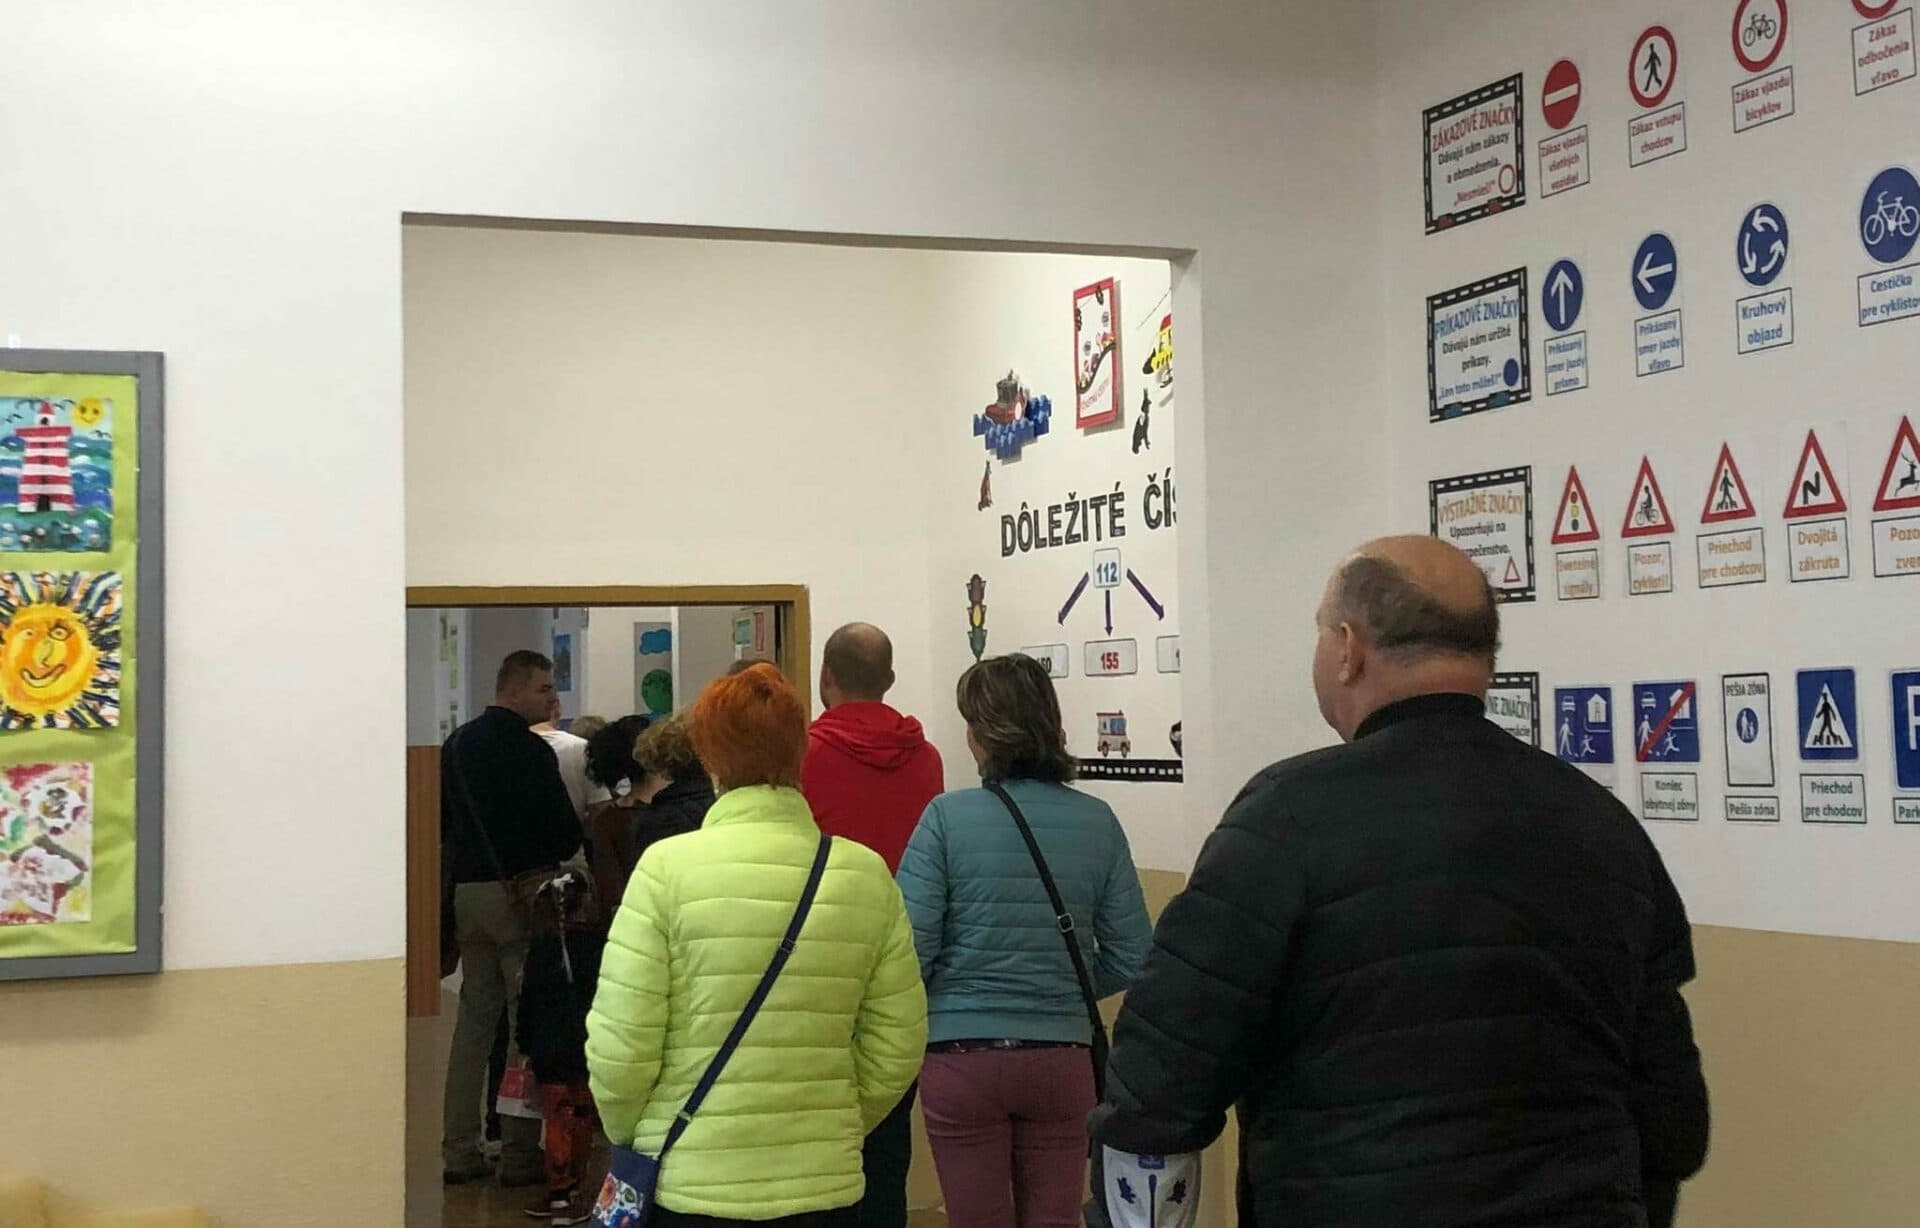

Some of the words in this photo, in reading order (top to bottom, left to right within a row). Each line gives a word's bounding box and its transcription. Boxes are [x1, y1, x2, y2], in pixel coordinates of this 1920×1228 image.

[1869, 24, 1897, 42] Zákaz
[1858, 40, 1910, 67] odbočenia
[1735, 87, 1760, 104] Zákaz
[1762, 75, 1790, 97] vjazdu
[1746, 101, 1781, 122] bicyklov
[1742, 297, 1786, 320] Kruhový
[1862, 306, 1877, 320] pre
[1747, 324, 1783, 345] objazd
[1001, 481, 1126, 557] DÔLEŽITÉ
[1144, 467, 1176, 530] ČÍ
[1496, 522, 1506, 532] na
[1798, 527, 1837, 546] Dvojitá
[1708, 537, 1752, 555] Priechod
[1096, 562, 1118, 584] 112
[1701, 567, 1718, 581] pre
[1720, 561, 1762, 577] chodcov
[1799, 556, 1840, 572] zákruta
[1101, 652, 1119, 670] 155
[1726, 682, 1746, 696] PEŠIA
[1655, 779, 1683, 791] Koniec
[1811, 781, 1853, 794] Priechod
[1805, 806, 1821, 817] pre
[1823, 803, 1863, 817] chodcov
